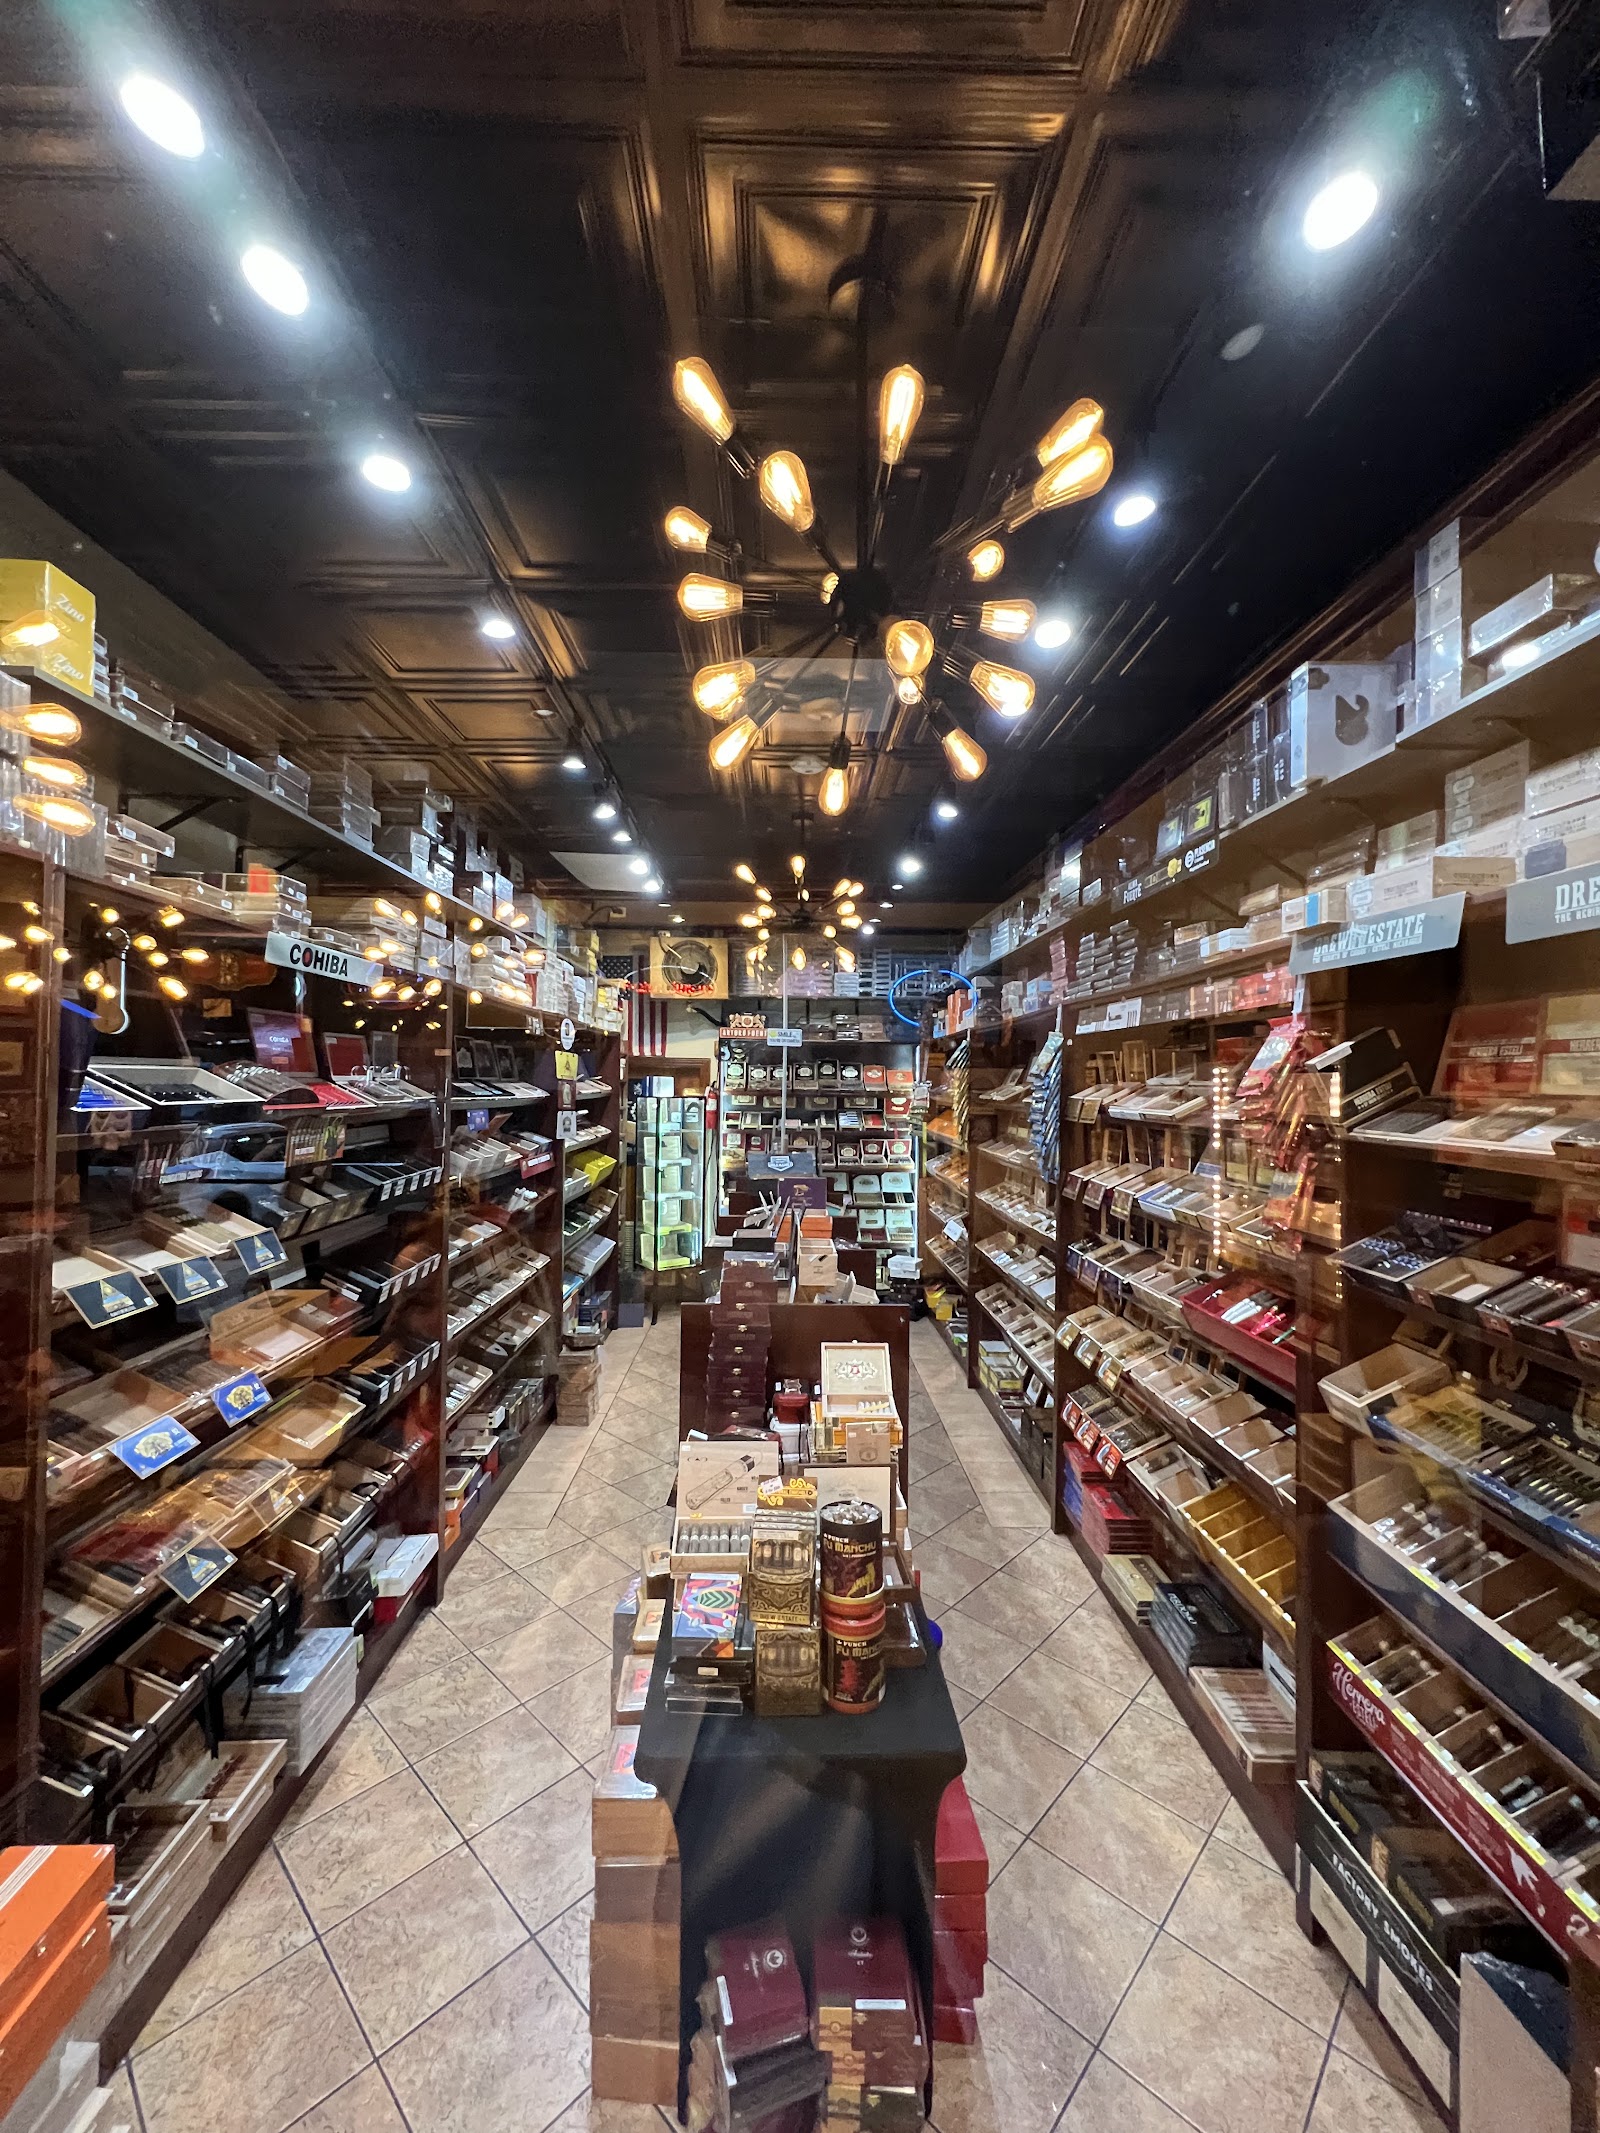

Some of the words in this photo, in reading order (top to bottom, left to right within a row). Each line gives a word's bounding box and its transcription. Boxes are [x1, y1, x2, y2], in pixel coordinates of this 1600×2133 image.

[55, 592, 86, 623] Zino
[50, 652, 85, 681] Zino
[1367, 913, 1427, 945] ESTATE
[289, 943, 349, 977] COHIBA
[722, 1029, 746, 1037] ARTURO
[747, 1029, 767, 1038] FUENT
[827, 1534, 849, 1544] PUNCH
[834, 1541, 877, 1553] MANCHU
[1331, 1662, 1386, 1726] Herrera
[1332, 1853, 1379, 1919] FACTORY
[1383, 1919, 1433, 1992] SMOKES
